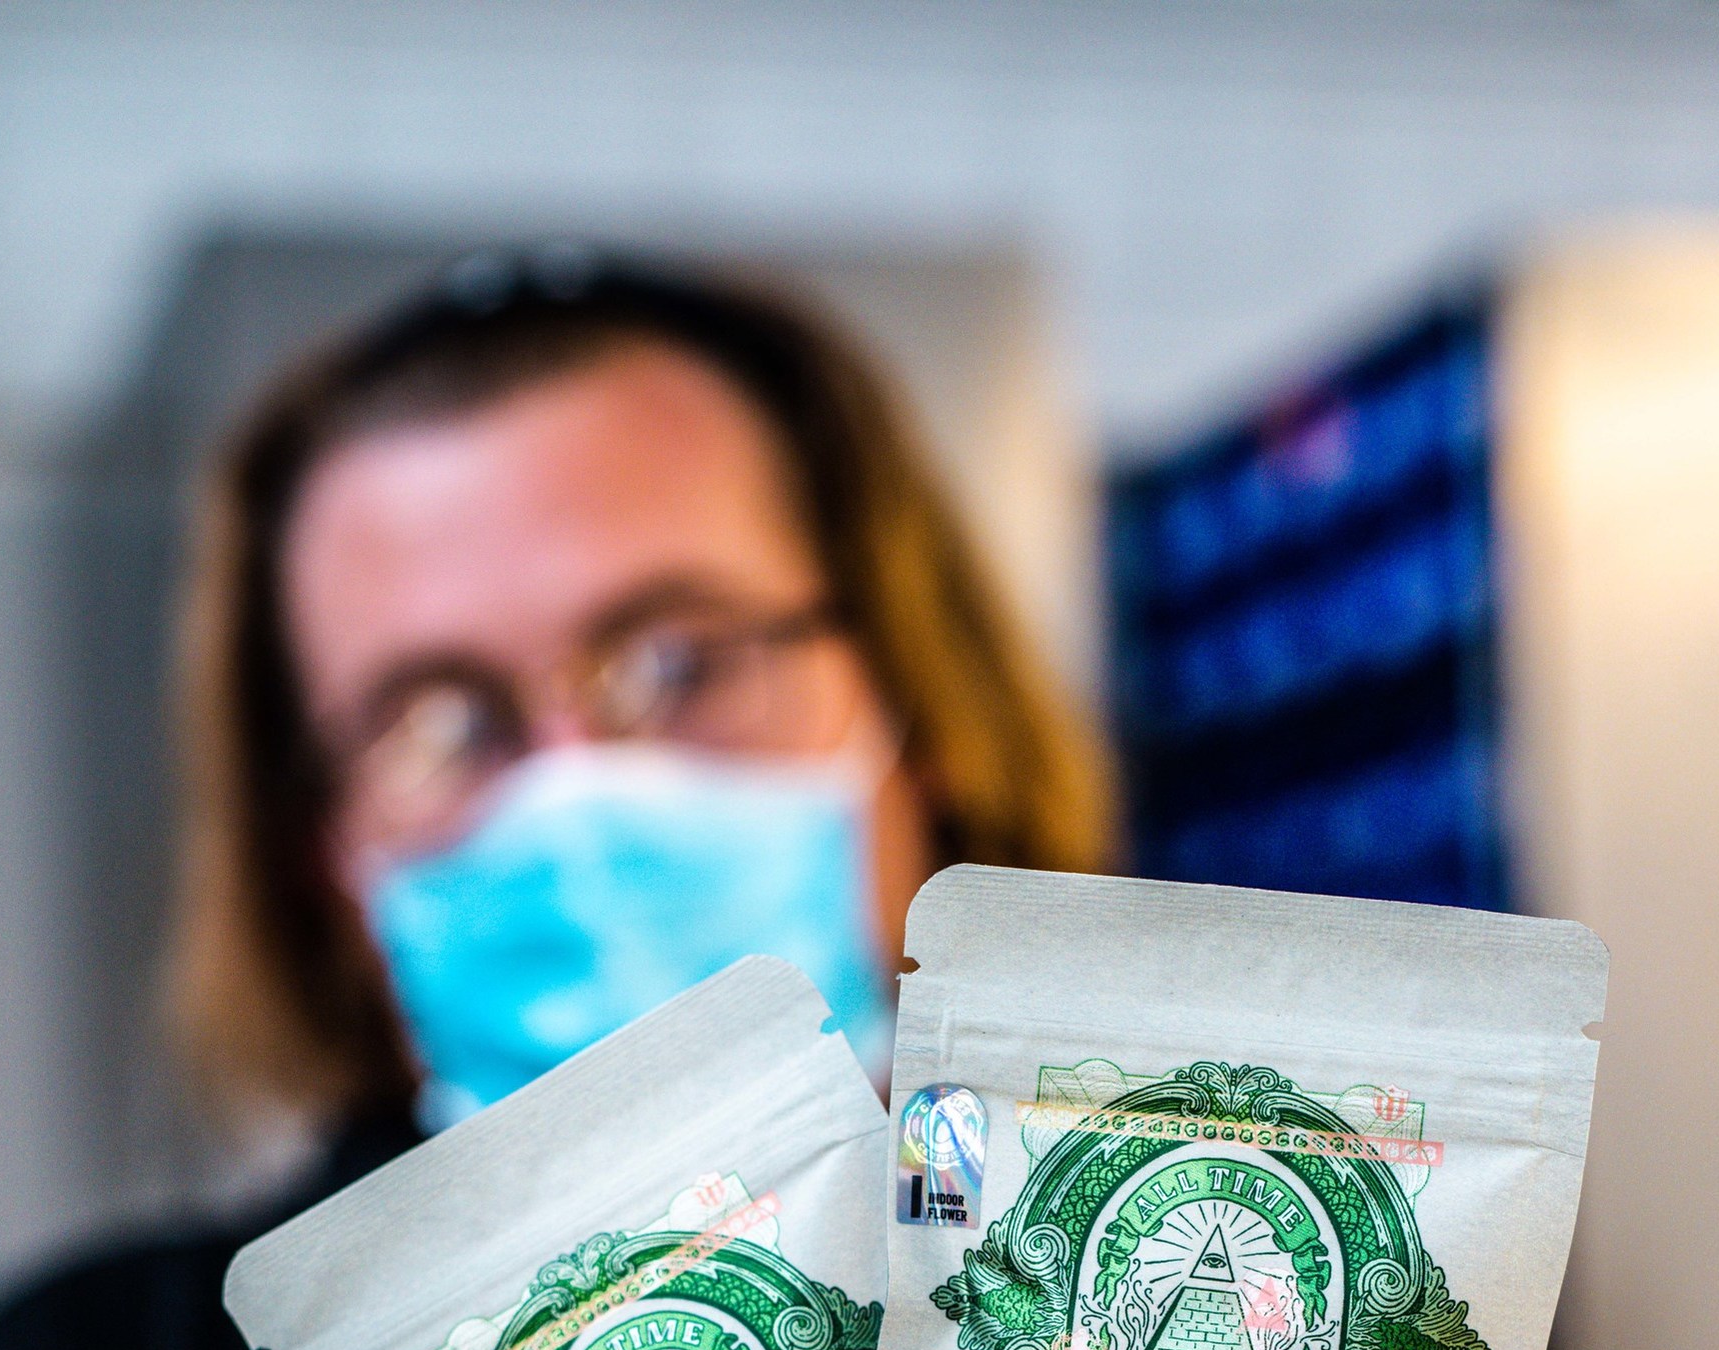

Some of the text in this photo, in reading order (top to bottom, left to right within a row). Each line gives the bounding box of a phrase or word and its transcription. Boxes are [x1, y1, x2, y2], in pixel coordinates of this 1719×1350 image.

[928, 1193, 964, 1207] INDOOR
[1135, 1166, 1305, 1233] ALL TIME
[928, 1207, 967, 1222] FLOWER
